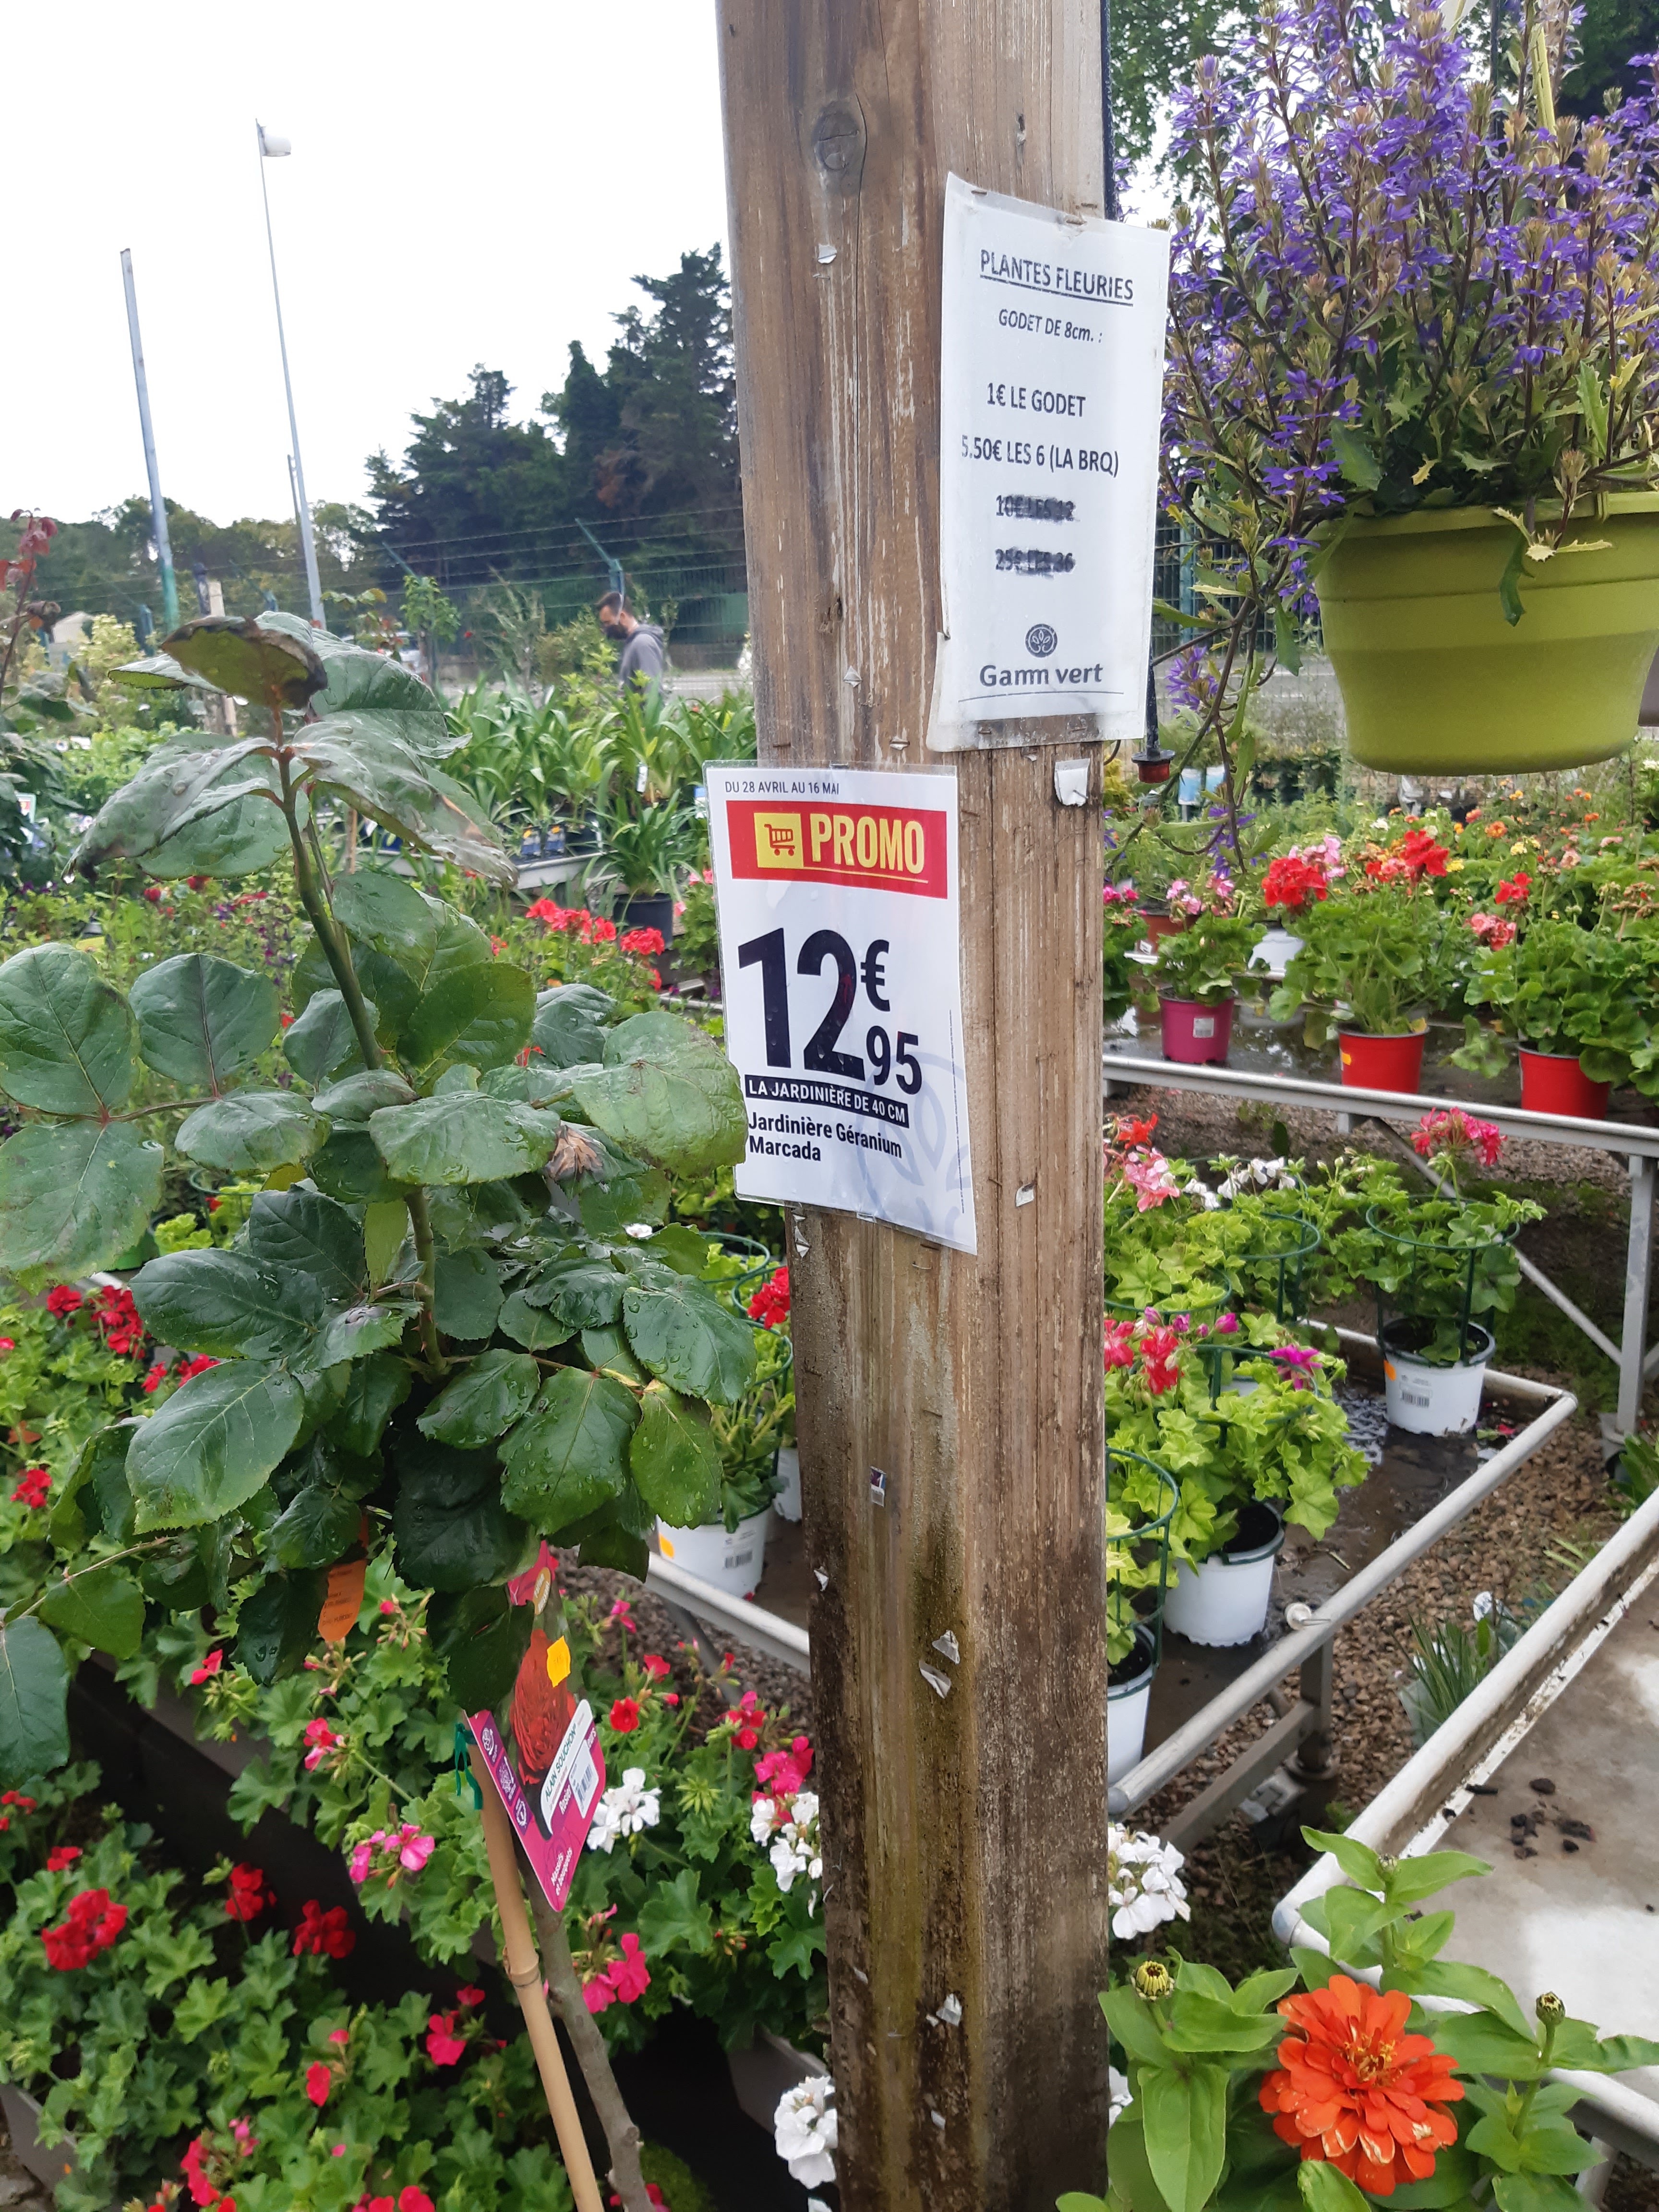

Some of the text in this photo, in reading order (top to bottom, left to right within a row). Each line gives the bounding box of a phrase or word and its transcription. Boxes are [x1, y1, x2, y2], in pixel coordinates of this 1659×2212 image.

[980, 249, 1133, 300] PLANTES FLEURIES
[998, 309, 1043, 333] GODET
[1045, 318, 1062, 336] DE
[1064, 322, 1094, 342] 8cm.
[987, 382, 1086, 417] 1€ LE GODET
[961, 434, 1118, 478] 5.50€ LES 6 (LA BRQ)
[980, 663, 1103, 686] Gamm vert
[725, 781, 839, 795] DU 28 AVRIL AU 16 MAI
[810, 813, 925, 874] PROMO
[738, 927, 866, 1082] 12
[866, 1025, 922, 1095] 95
[749, 1080, 905, 1123] LA JARDINIÈRE DE 40 CM
[748, 1111, 902, 1159] Jardinière Géranium
[749, 1135, 821, 1161] Marcada
[545, 1770, 557, 1802] ALAIN
[559, 1784, 572, 1815] Rosier
